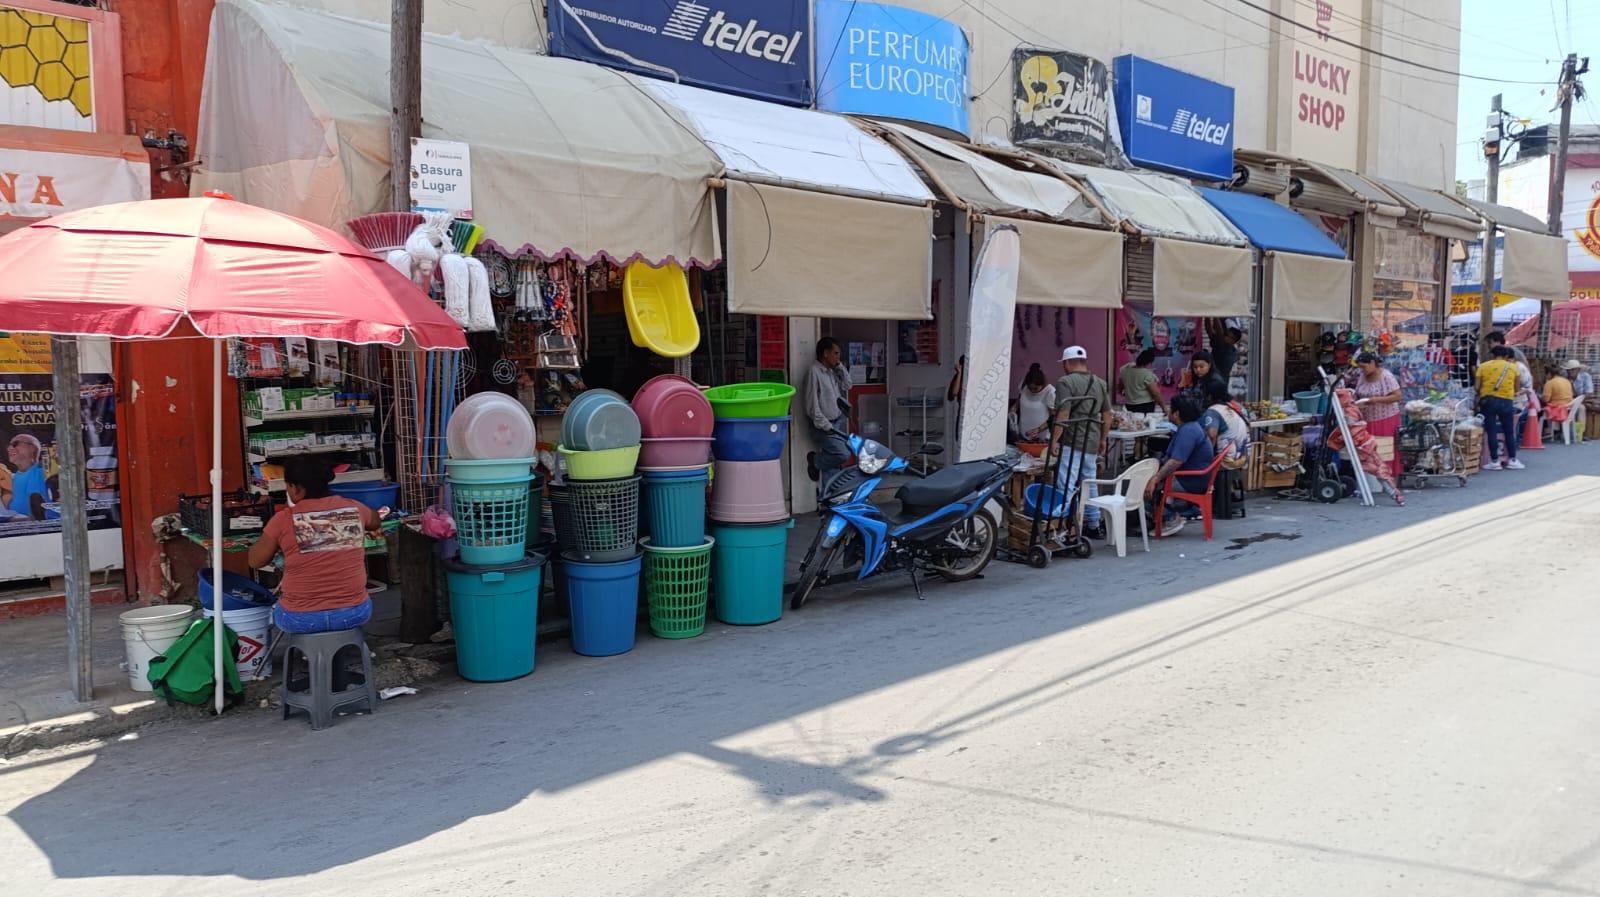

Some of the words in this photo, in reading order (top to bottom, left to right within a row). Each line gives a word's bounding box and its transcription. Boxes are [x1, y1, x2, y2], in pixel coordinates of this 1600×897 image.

[571, 6, 617, 24] DISTRIBUIDOR
[617, 18, 657, 34] AUTORIZADO
[701, 10, 803, 64] telcel
[849, 27, 963, 77] PERFUMES
[849, 62, 963, 109] EUROPEOS
[1294, 50, 1351, 96] LUCKY
[1186, 113, 1230, 146] telcel
[1298, 93, 1345, 131] SHOP
[420, 163, 463, 177] Basura
[421, 179, 457, 194] Lugar
[22, 404, 45, 412] UNA
